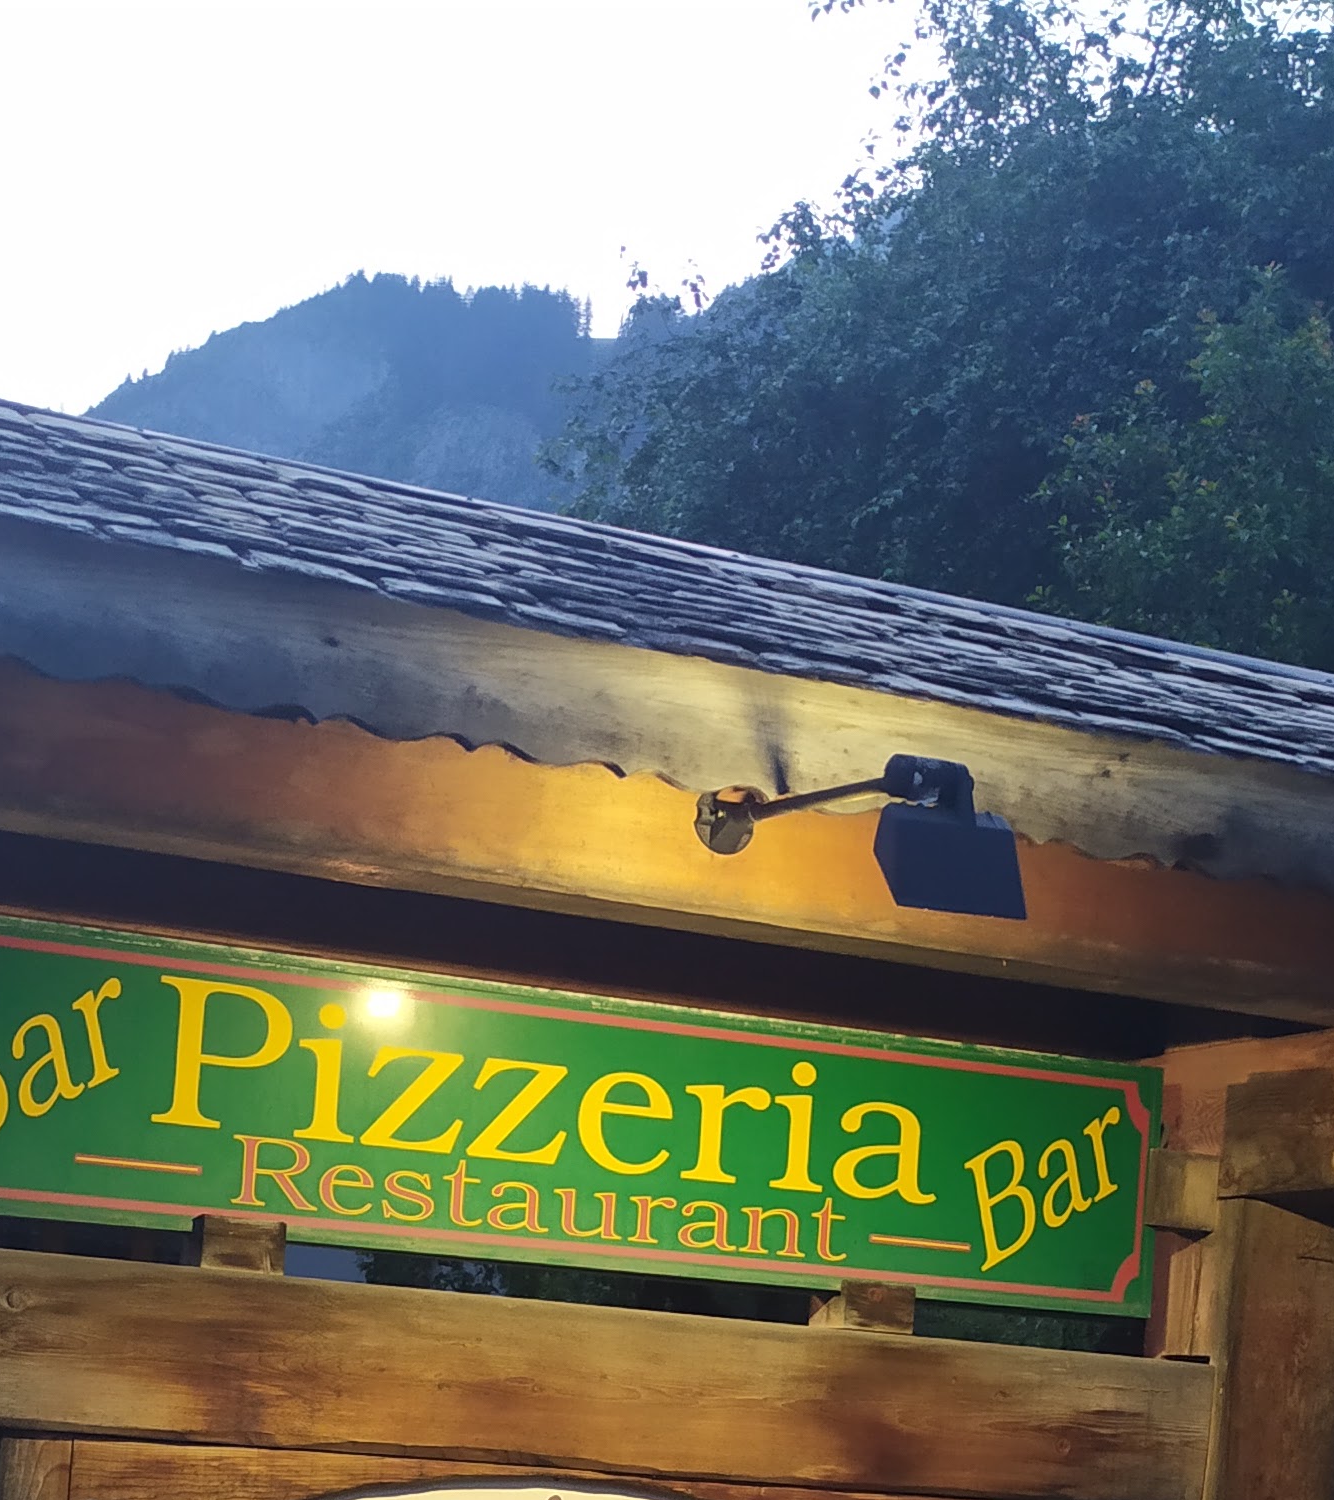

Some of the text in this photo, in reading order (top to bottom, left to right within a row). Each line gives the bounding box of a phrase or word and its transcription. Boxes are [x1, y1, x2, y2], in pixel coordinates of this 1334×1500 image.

[150, 973, 937, 1207] Pizzeria
[964, 1105, 1121, 1273] Bar
[230, 1133, 848, 1263] Restaurant
